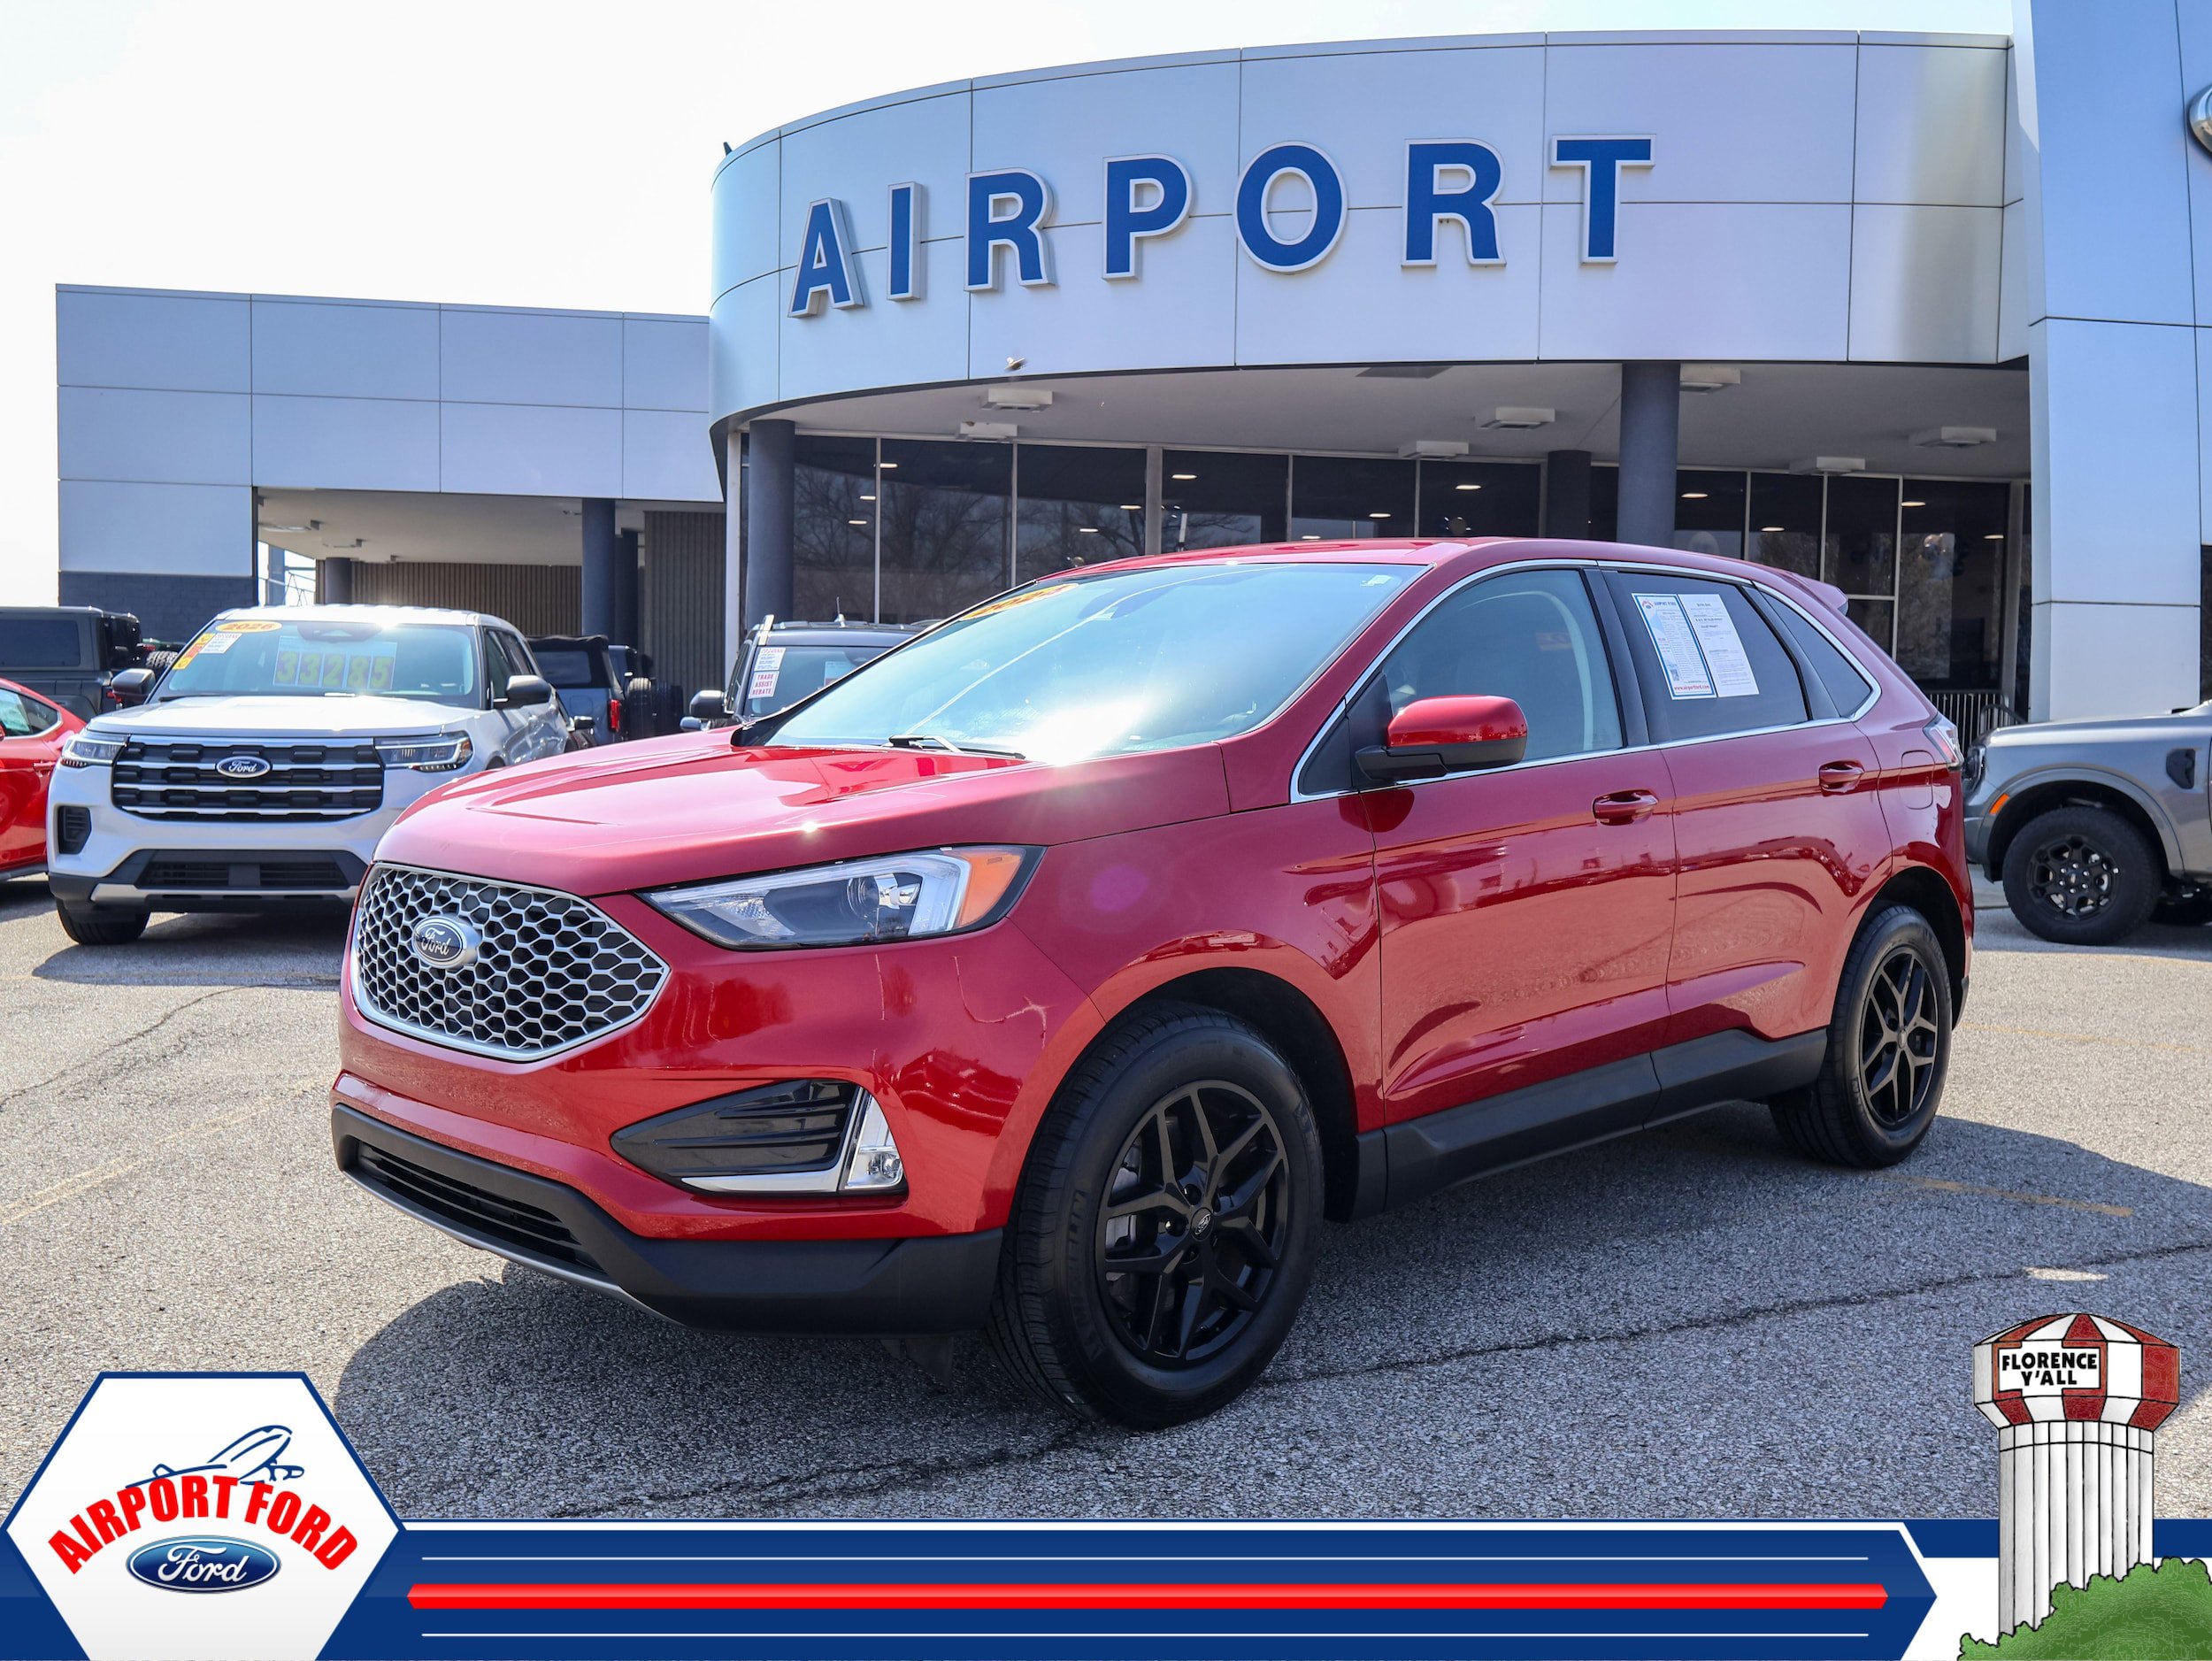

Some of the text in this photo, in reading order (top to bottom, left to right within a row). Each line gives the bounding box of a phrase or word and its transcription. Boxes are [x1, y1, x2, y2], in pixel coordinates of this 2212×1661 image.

[787, 134, 1656, 317] AIRPORT
[277, 651, 393, 688] 33285
[228, 760, 257, 773] Ford
[420, 927, 452, 956] Ford
